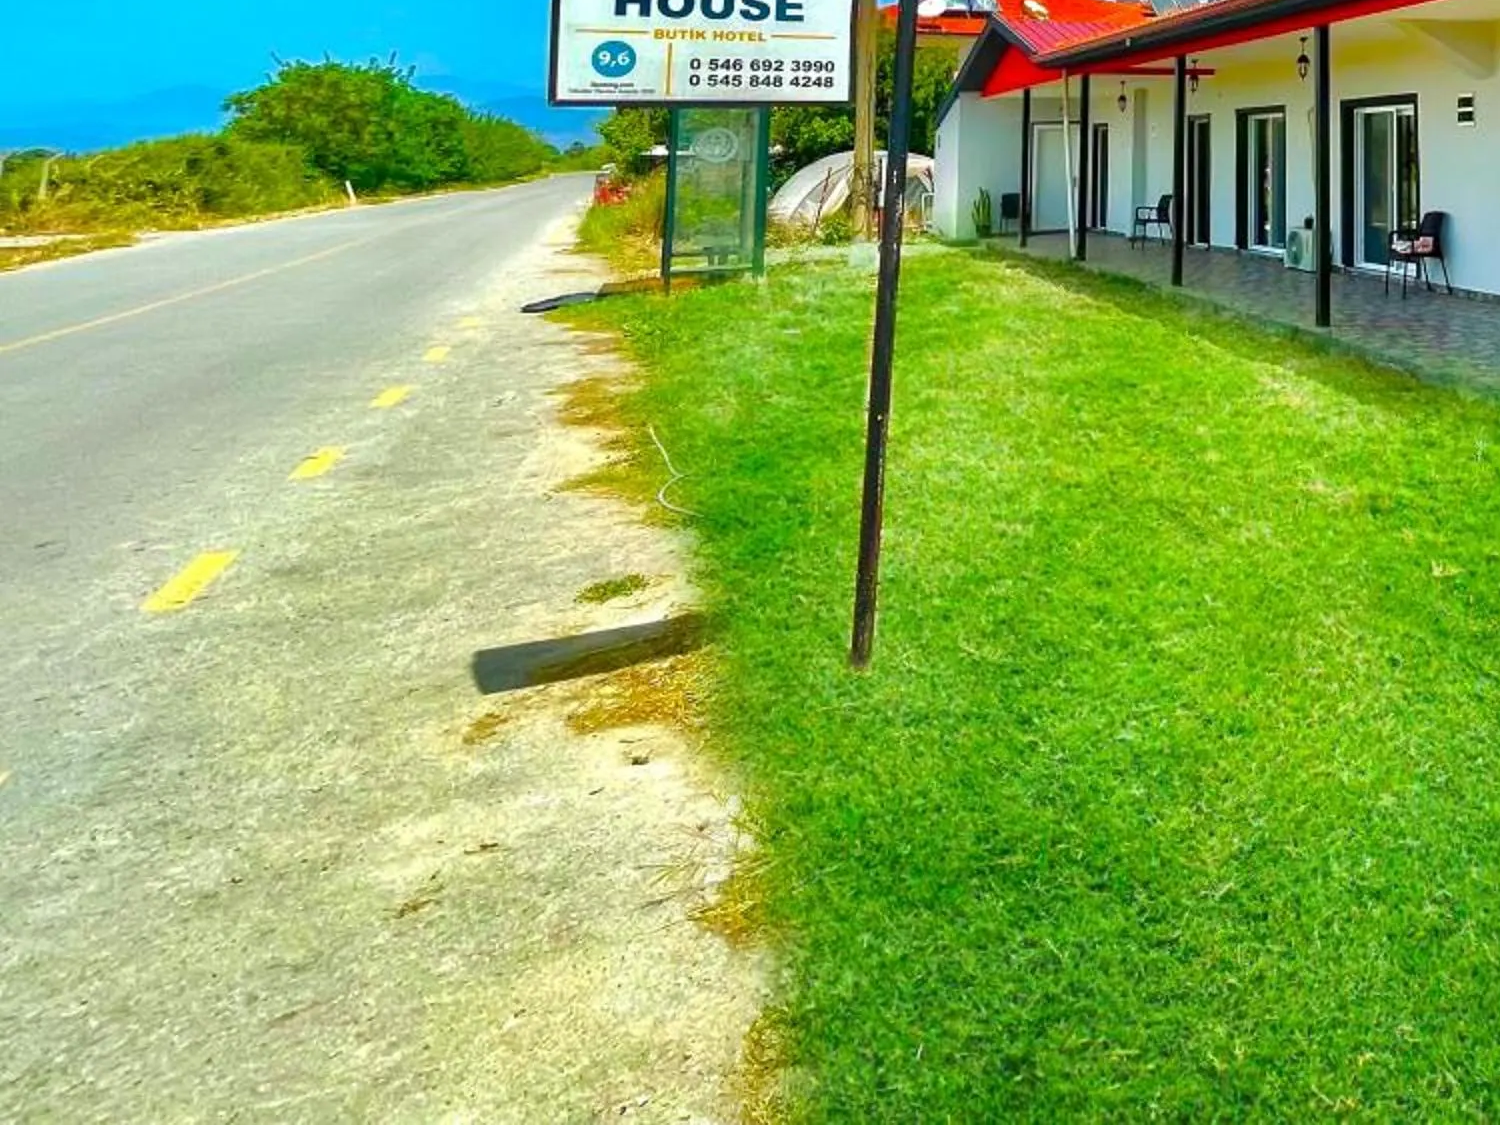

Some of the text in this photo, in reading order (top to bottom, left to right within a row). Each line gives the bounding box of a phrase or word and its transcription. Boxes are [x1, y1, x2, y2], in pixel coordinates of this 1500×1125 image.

[713, 30, 767, 42] HOTEL
[598, 50, 631, 68] 9,6
[690, 58, 835, 73] 0 546 692 3990
[689, 74, 834, 88] 0 545 848 4248
